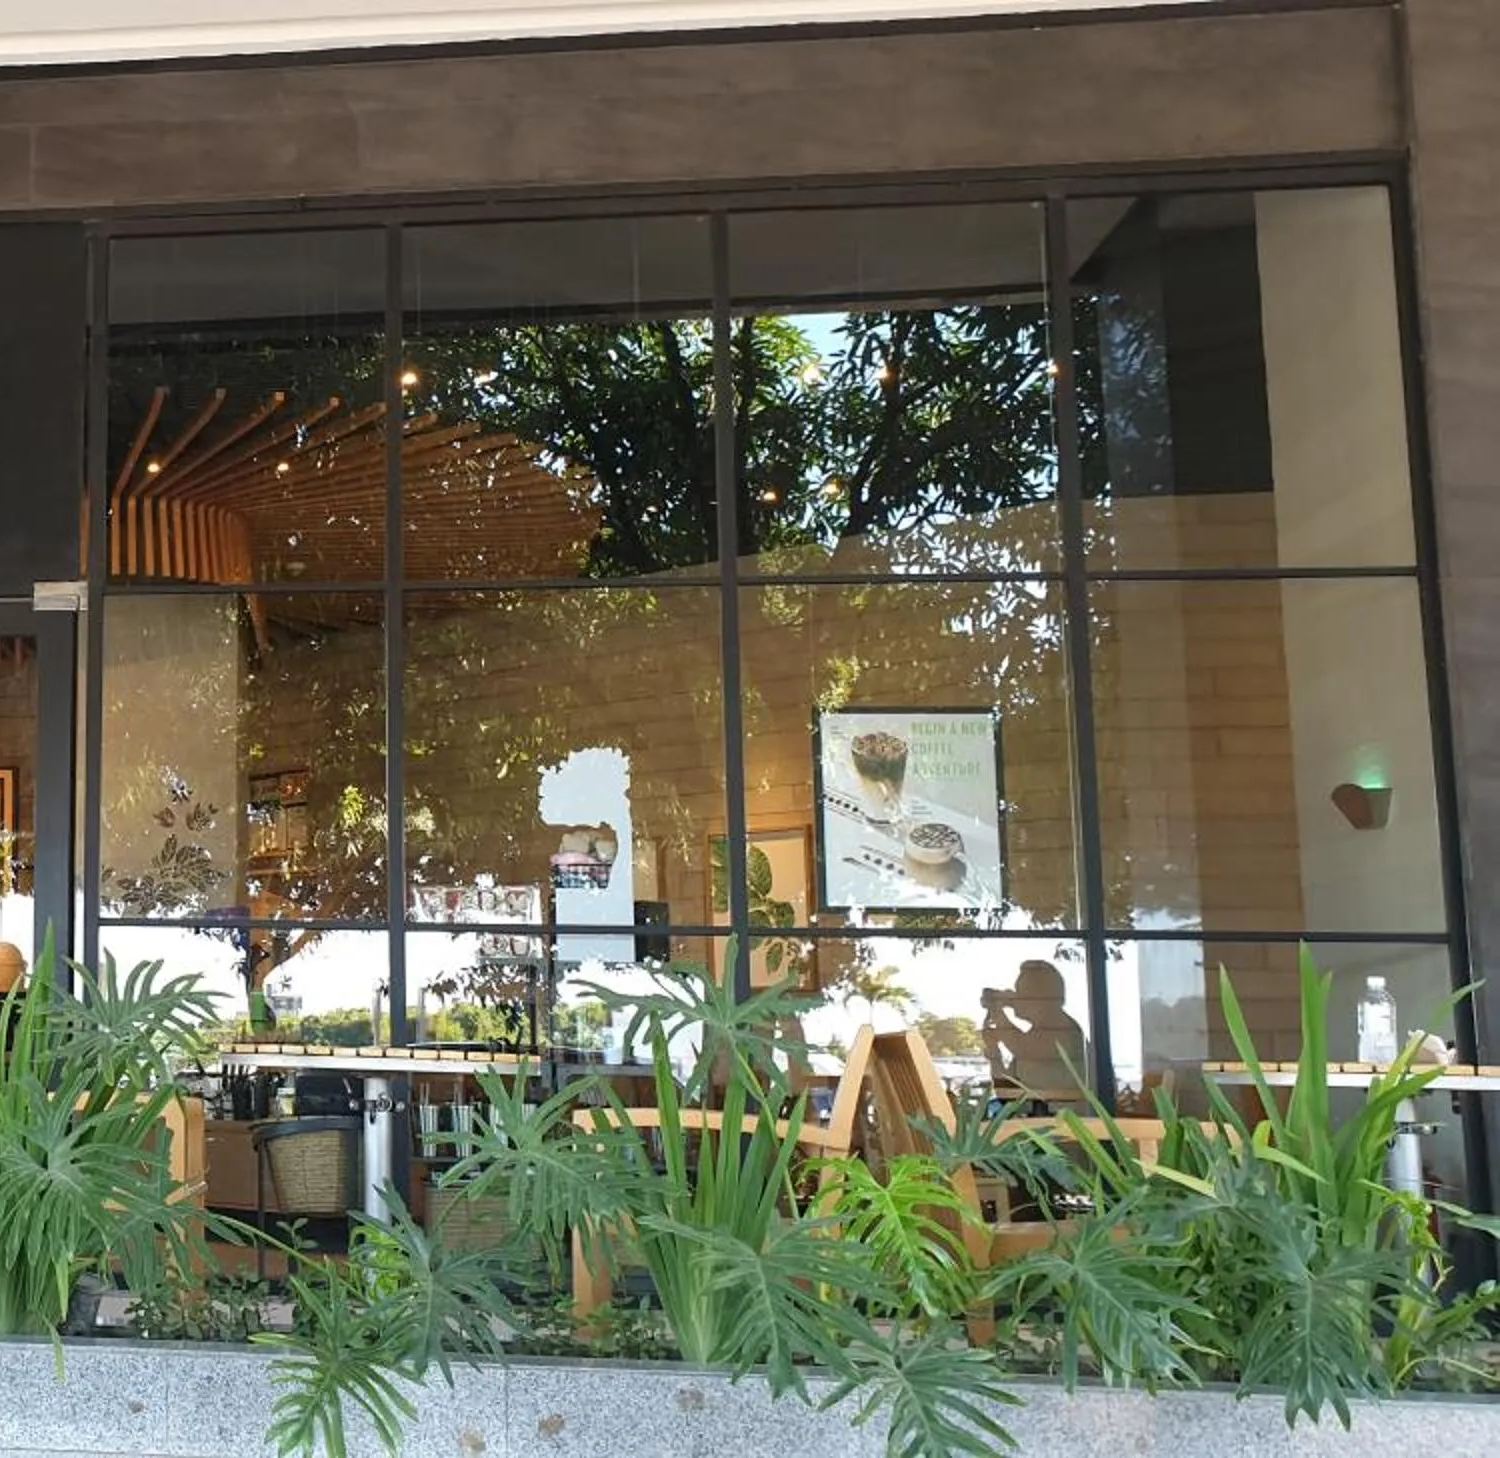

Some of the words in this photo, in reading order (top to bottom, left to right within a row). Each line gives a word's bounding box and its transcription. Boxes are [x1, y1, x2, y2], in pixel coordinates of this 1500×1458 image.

[911, 722, 946, 735] BEGIN
[950, 721, 957, 735] A
[961, 721, 987, 735] NEW
[911, 742, 952, 755] COFFEE
[912, 761, 981, 775] ADVENTURE
